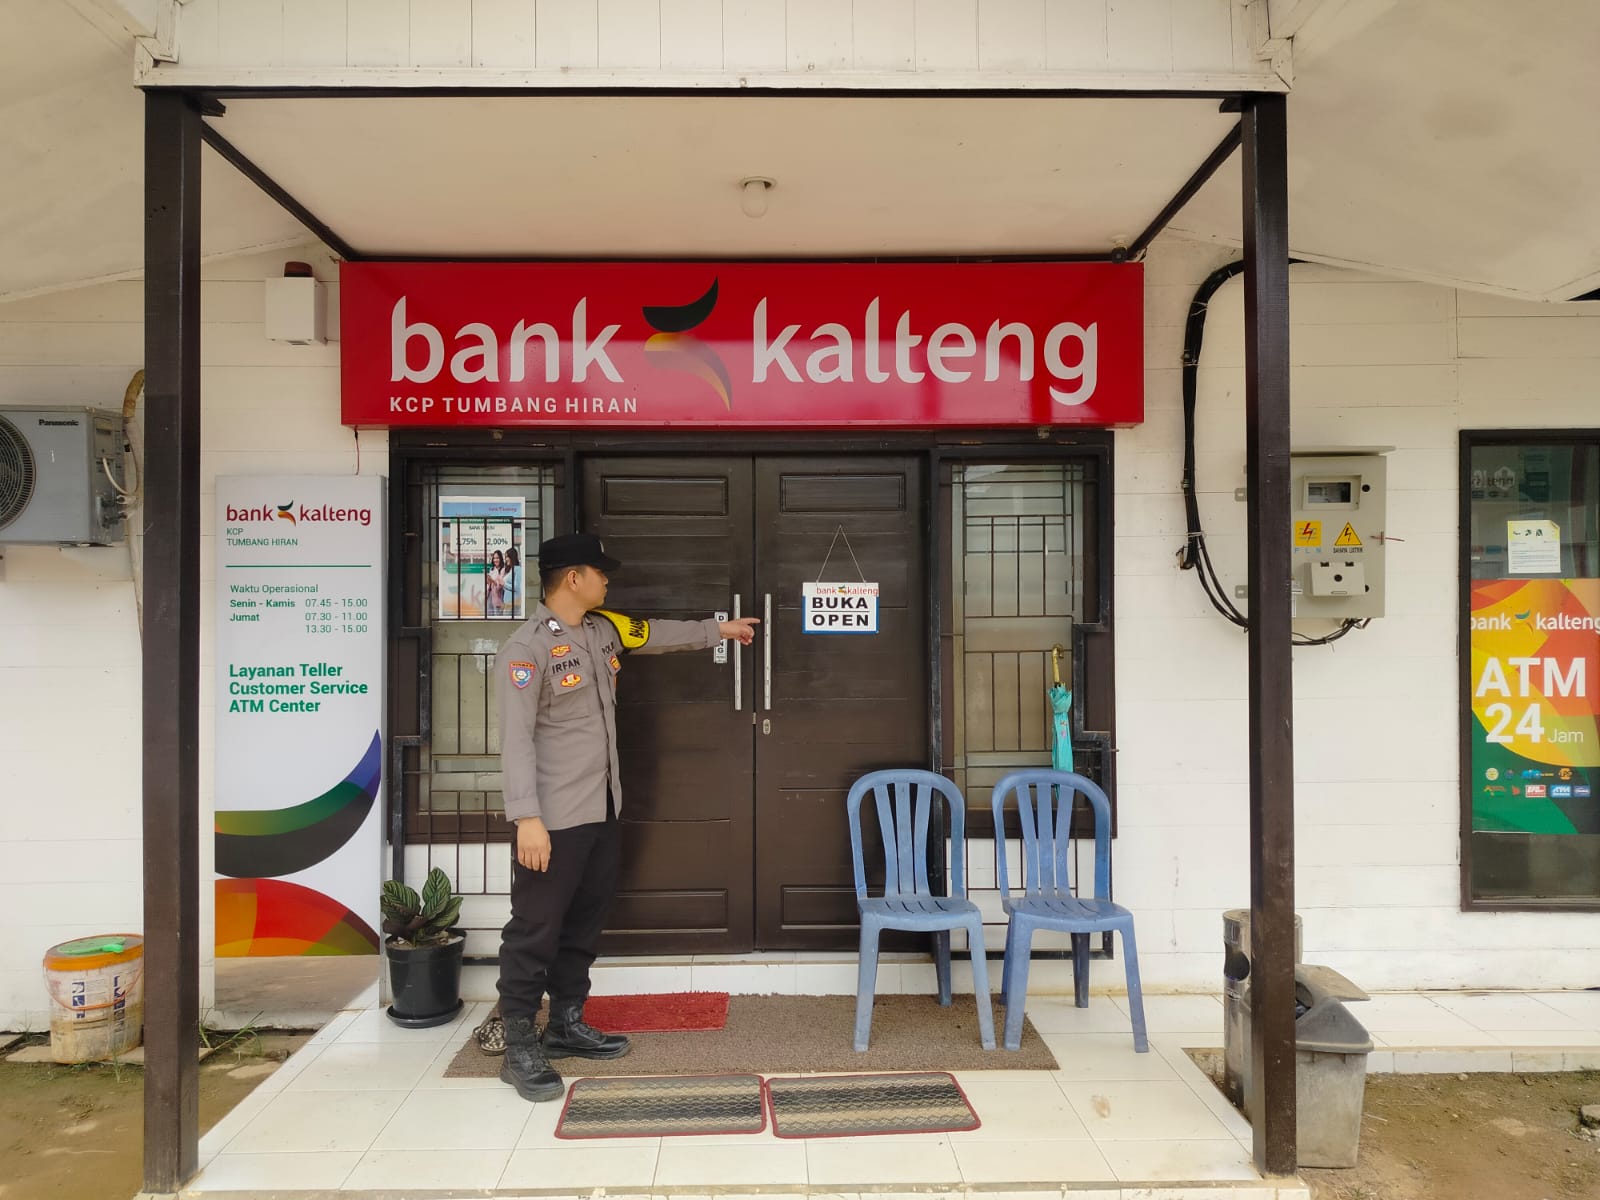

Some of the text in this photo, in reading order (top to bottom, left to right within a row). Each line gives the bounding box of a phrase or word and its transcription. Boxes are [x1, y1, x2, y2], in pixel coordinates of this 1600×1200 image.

[391, 295, 1098, 406] bank kalteng
[390, 397, 637, 413] KCP TUMBANG HIRAN
[226, 504, 371, 526] bank kalteng
[226, 528, 244, 536] KCP
[227, 538, 298, 546] TUMBANG HIRAN
[230, 584, 319, 595] Waktu Operasional
[816, 586, 879, 596] bank kalteng
[230, 599, 256, 608] Senin
[266, 599, 296, 608] Kamis
[305, 599, 331, 608] 07.45
[342, 599, 368, 608] 15.00
[812, 597, 868, 609] BUKA
[230, 613, 260, 622] Jumat
[305, 612, 331, 621] 07.30
[342, 612, 368, 621] 11.00
[812, 614, 869, 626] OPEN
[305, 625, 331, 633] 13.30
[342, 625, 368, 633] 15.00
[229, 663, 343, 680] Layanan Teller
[552, 657, 581, 675] IRFAN
[1475, 657, 1586, 697] ATM
[229, 680, 368, 695] Customer Service
[229, 699, 321, 713] ATM Center
[1485, 703, 1584, 744] 24 Jam
